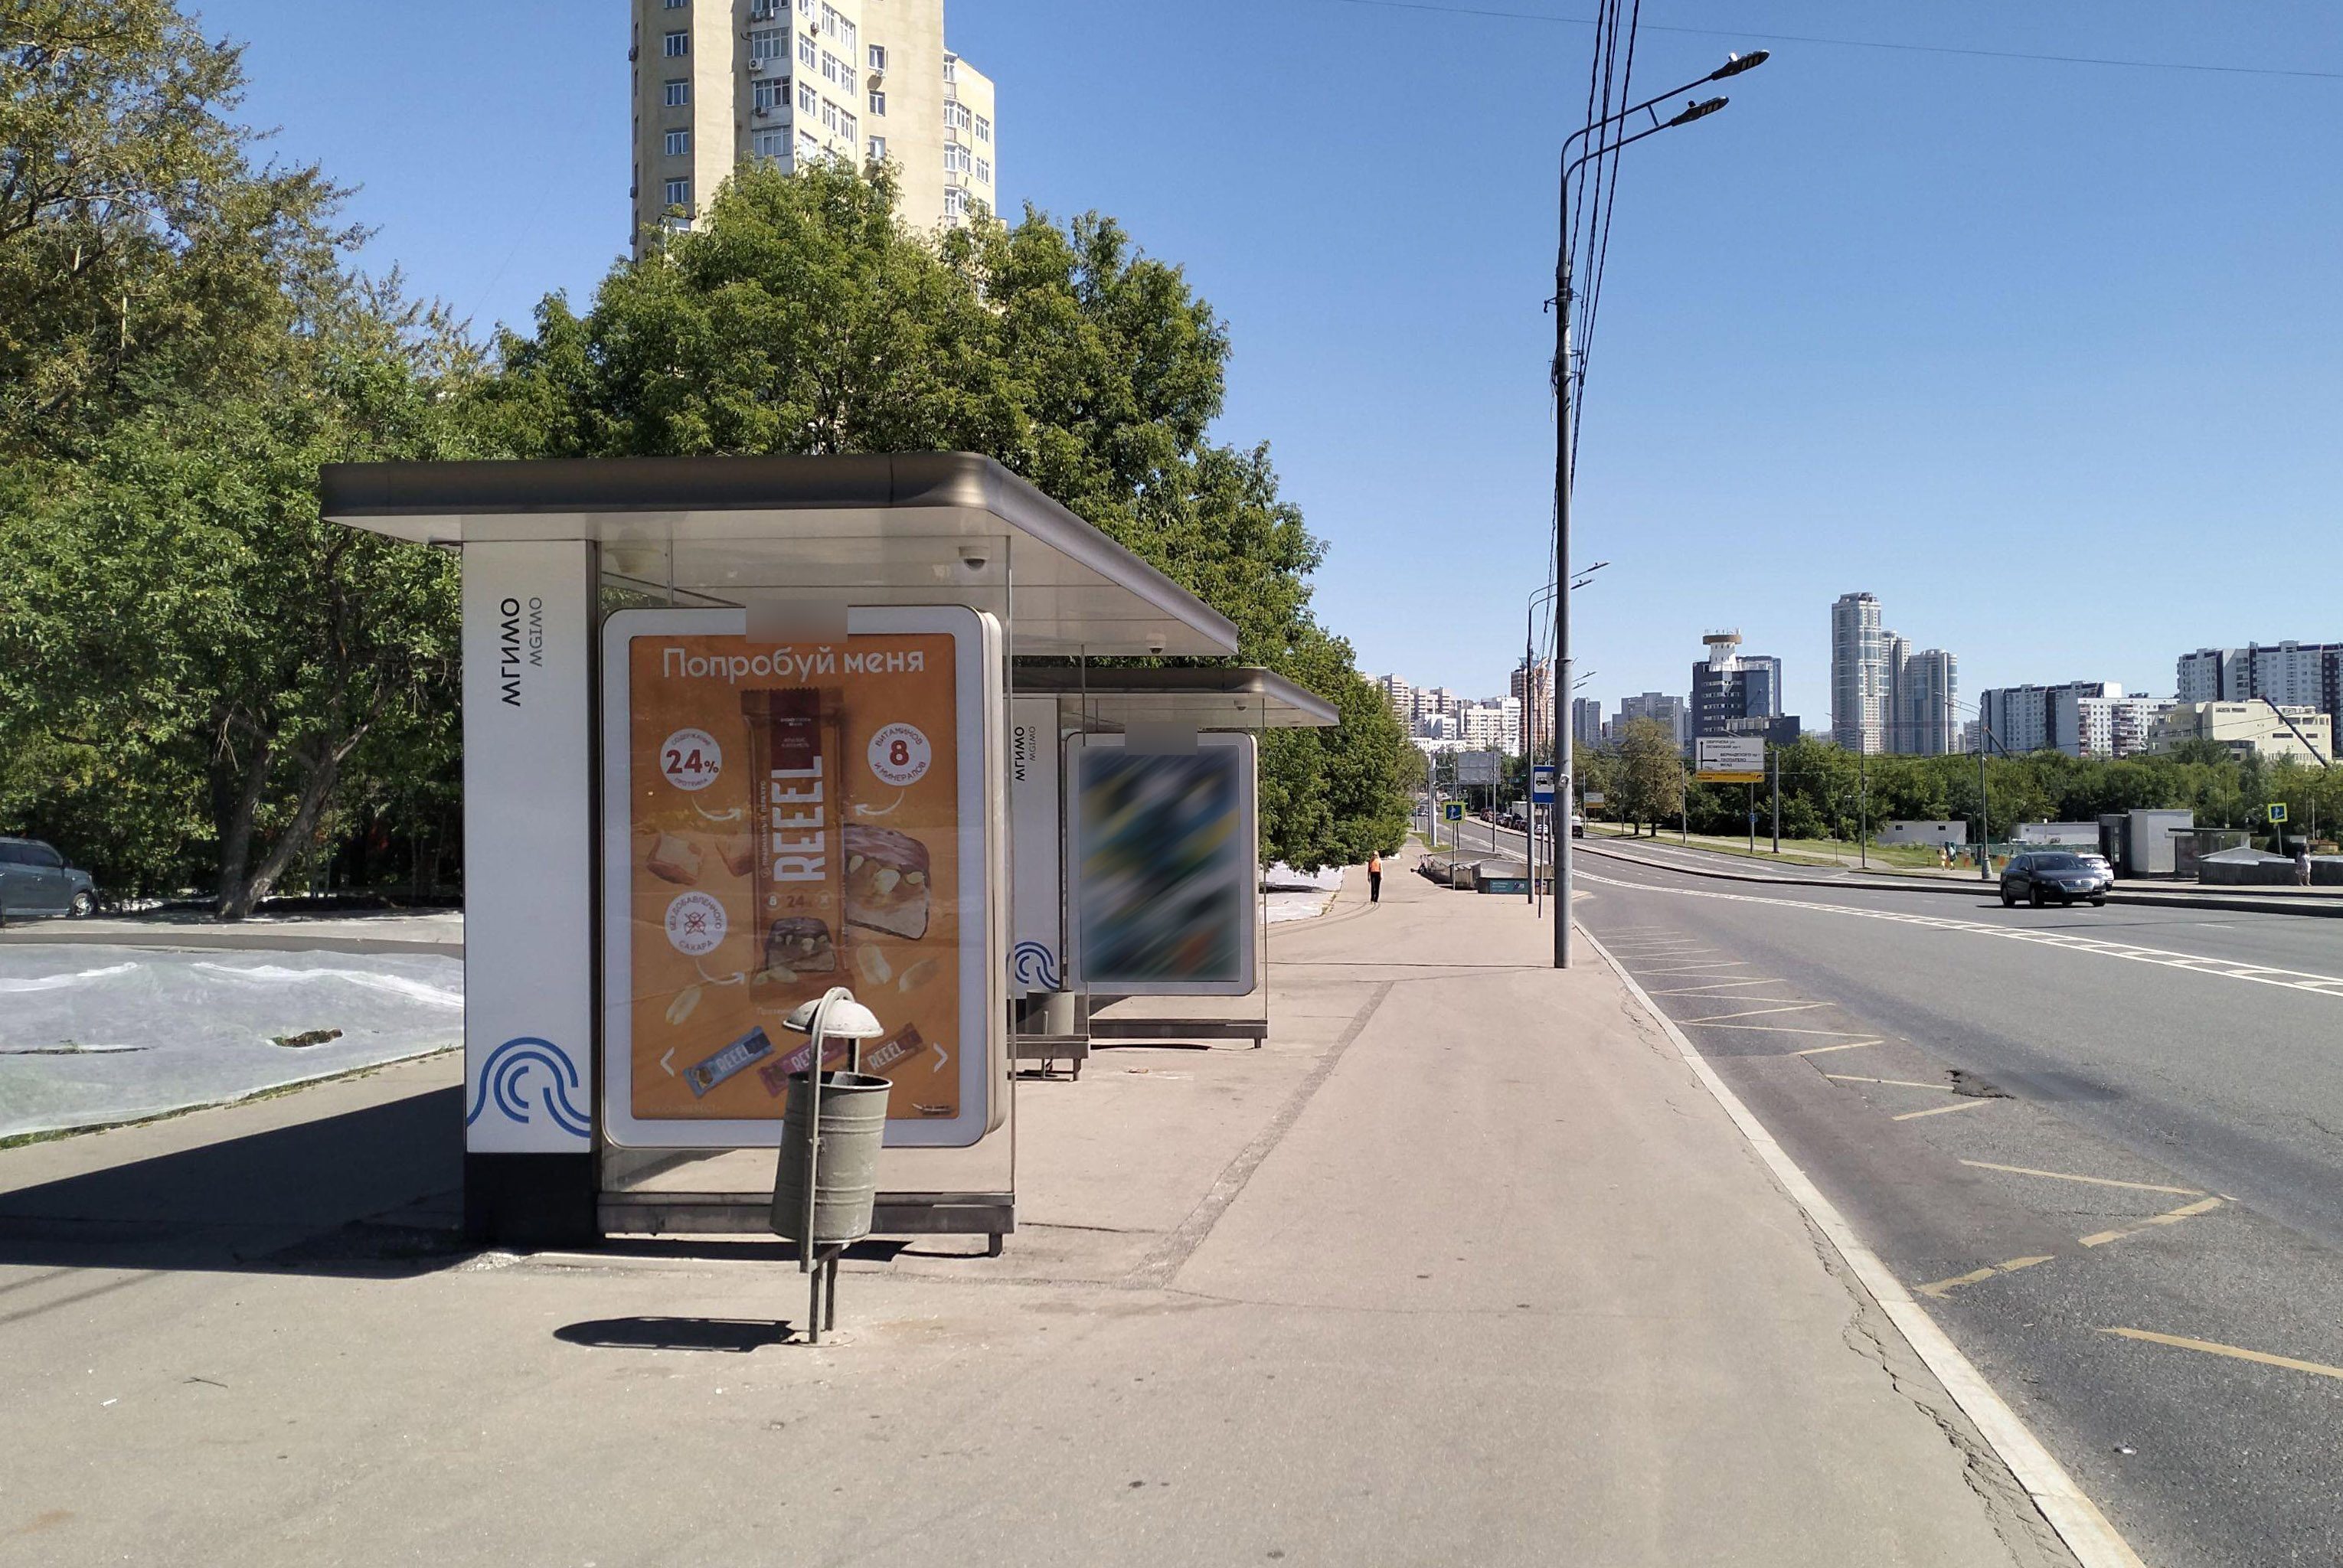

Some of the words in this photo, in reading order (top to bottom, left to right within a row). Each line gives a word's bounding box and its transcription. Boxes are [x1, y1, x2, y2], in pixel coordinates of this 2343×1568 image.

[528, 597, 542, 668] MGIMO
[501, 598, 521, 707] МГИМО
[663, 646, 835, 684] Попробуй
[844, 650, 924, 674] меня
[874, 727, 923, 747] ВИТАМИНОВ
[890, 740, 910, 766] 8
[1015, 727, 1025, 781] МГИМО
[770, 756, 825, 881] REEEL
[672, 896, 722, 929] ДОБАВЛЕННОГО
[678, 940, 714, 950] САХАРА
[716, 1044, 755, 1071] REEEL
[866, 1041, 906, 1070] REEEL
